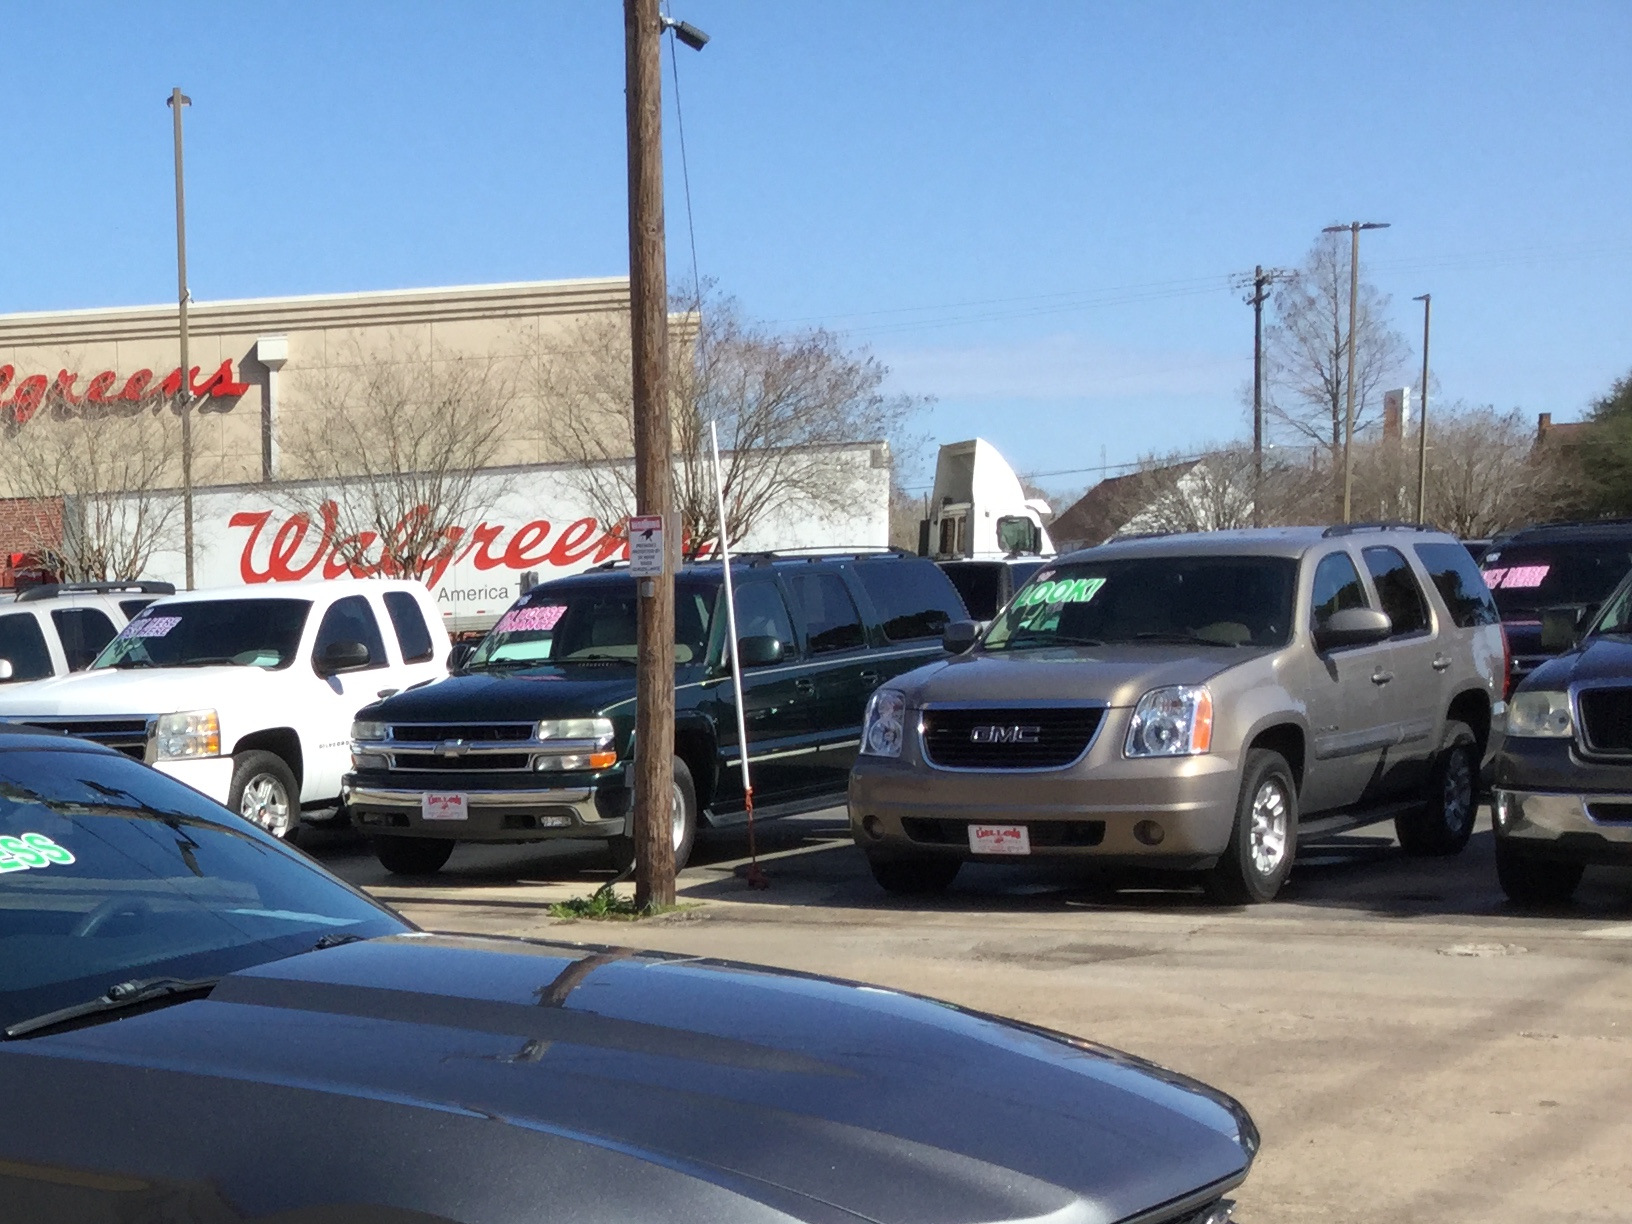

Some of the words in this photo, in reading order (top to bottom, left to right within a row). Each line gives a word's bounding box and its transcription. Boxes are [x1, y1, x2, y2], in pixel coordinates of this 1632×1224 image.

[437, 585, 509, 602] America
[1011, 577, 1107, 614] LOOK!
[970, 726, 1041, 743] GMC
